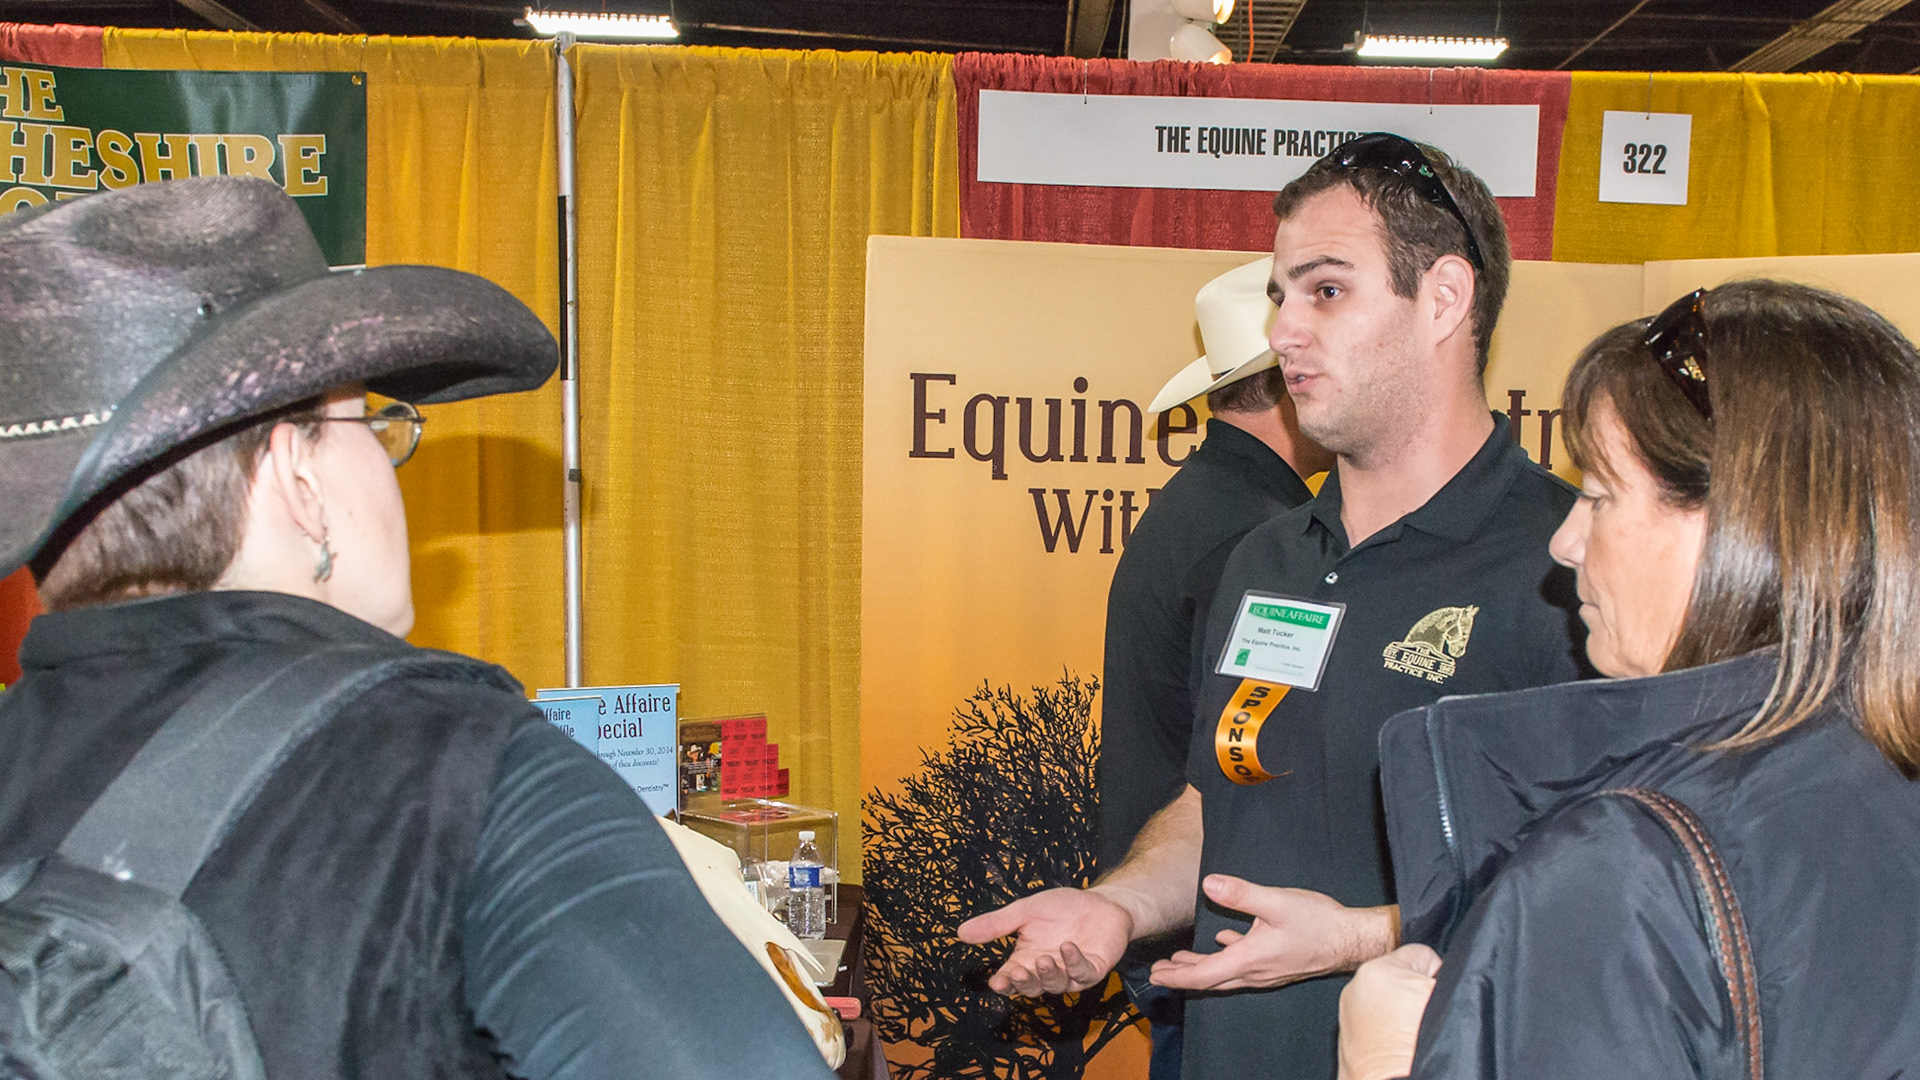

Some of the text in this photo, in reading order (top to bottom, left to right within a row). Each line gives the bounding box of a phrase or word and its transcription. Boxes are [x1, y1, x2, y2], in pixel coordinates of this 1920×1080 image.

[1155, 125, 1366, 158] THE EQUINE PRACTI
[1623, 142, 1667, 175] 322
[909, 373, 1198, 480] Equine
[1028, 487, 1162, 554] Wit
[1252, 605, 1326, 625] EQUINE AFFAIRE
[1251, 639, 1268, 647] Equine
[1257, 627, 1294, 638] Matt Tucker
[1401, 652, 1436, 670] EQUINE
[1383, 661, 1425, 678] PRACTICE
[1426, 673, 1444, 684] INC.
[613, 693, 671, 714] Affaire
[617, 748, 644, 757] November
[657, 746, 673, 755] 2014
